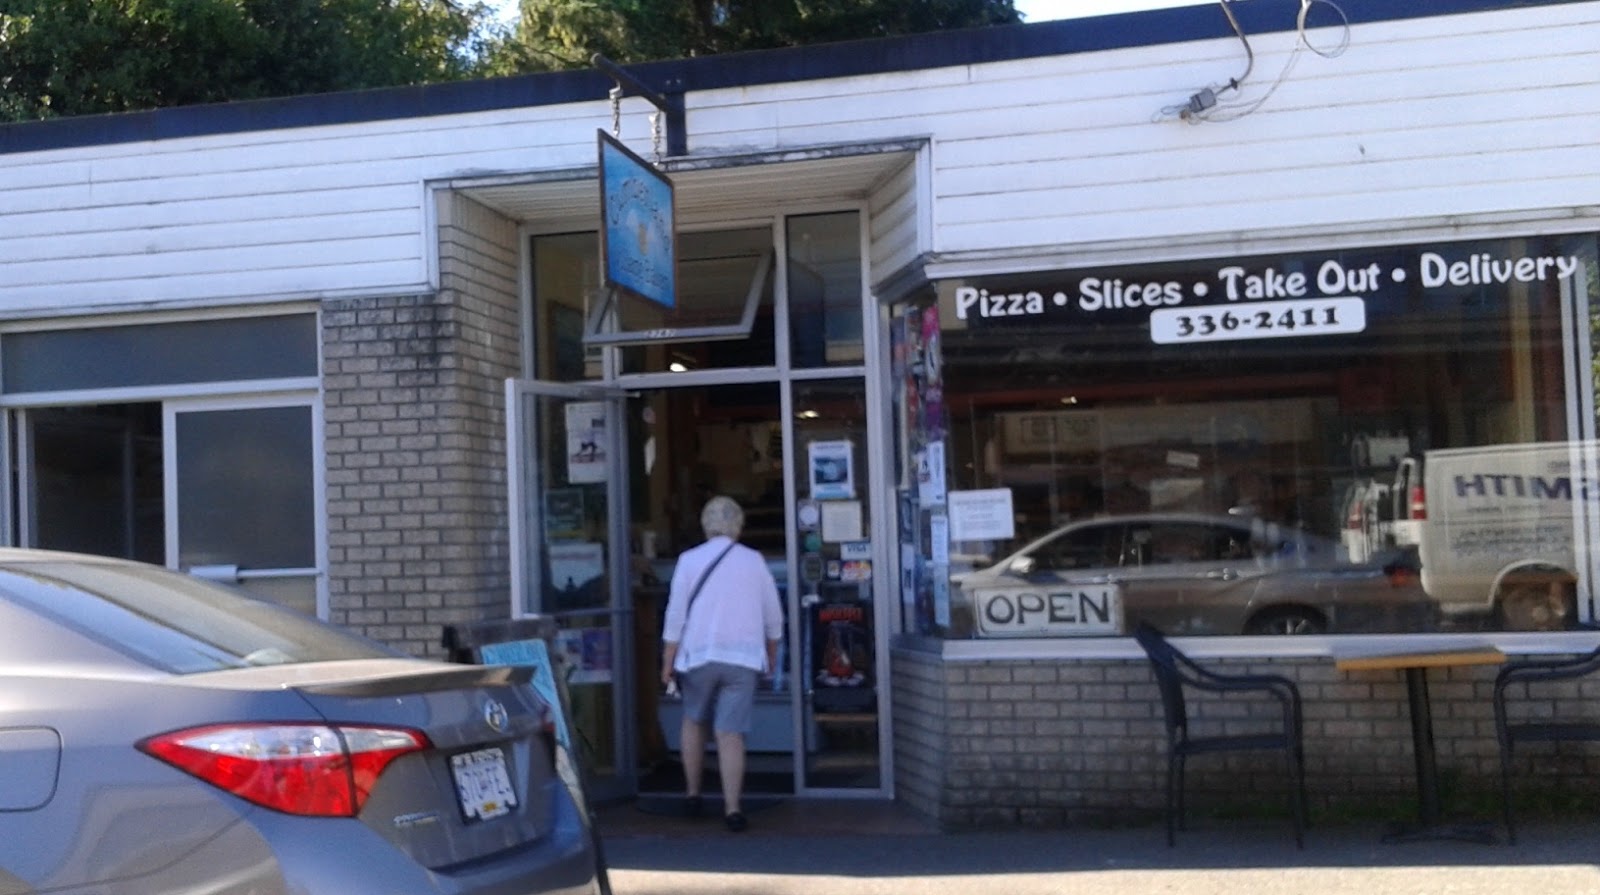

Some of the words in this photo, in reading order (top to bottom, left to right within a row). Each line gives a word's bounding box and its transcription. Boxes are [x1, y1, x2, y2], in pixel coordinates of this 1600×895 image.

[955, 286, 1044, 320] Pizza
[1078, 277, 1183, 311] Slices
[1218, 265, 1307, 300] Take
[1317, 260, 1381, 295] Out
[1420, 252, 1578, 288] Delivery
[1176, 305, 1340, 338] 336-2411
[985, 591, 1110, 624] OPEN
